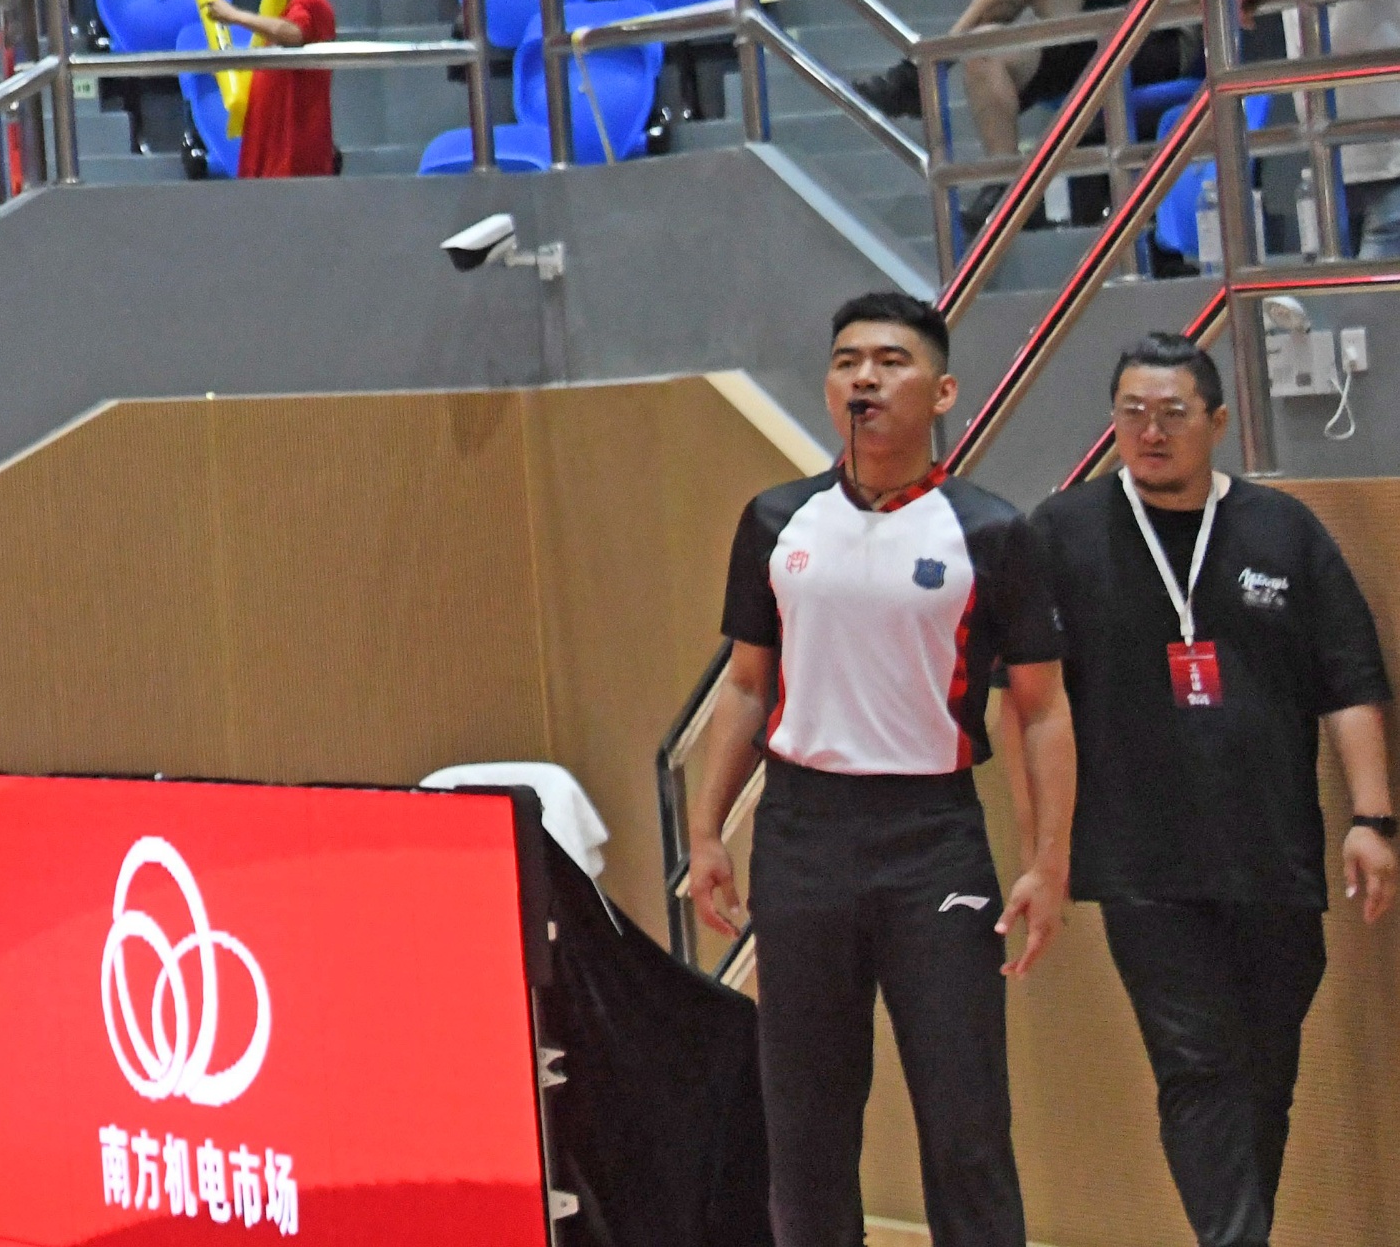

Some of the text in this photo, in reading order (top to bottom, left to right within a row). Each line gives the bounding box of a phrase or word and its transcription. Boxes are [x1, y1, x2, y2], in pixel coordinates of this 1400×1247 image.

[97, 1123, 300, 1237] 南方机电市场
